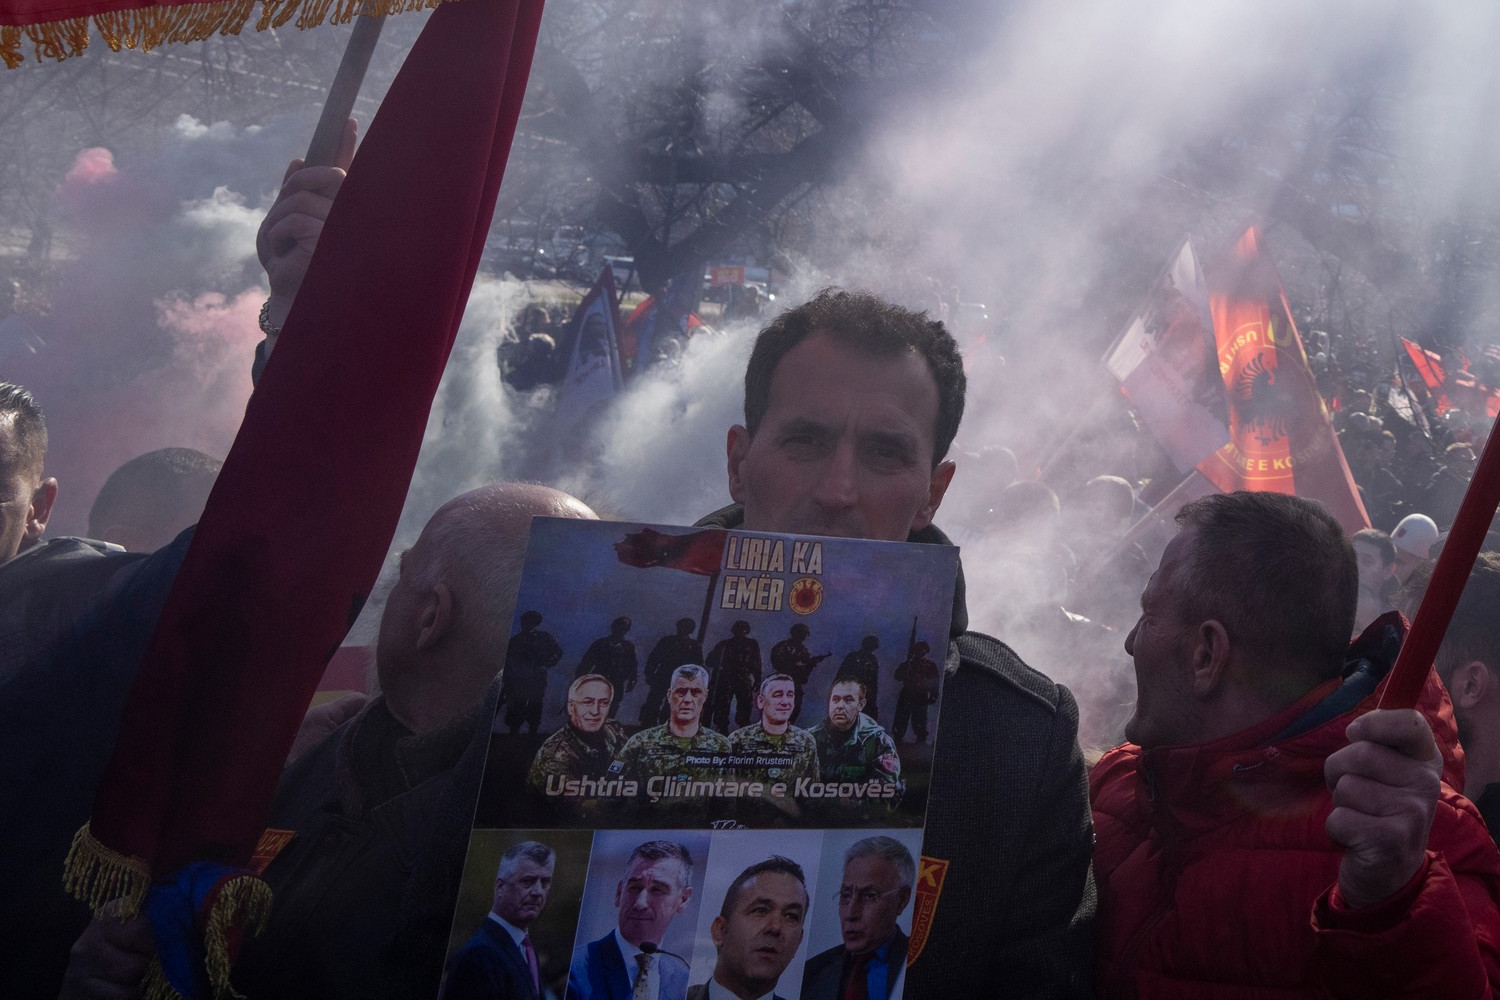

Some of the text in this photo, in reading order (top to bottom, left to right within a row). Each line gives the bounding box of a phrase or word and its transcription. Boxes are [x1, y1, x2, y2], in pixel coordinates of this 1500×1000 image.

[725, 536, 823, 575] LIRIA KA
[720, 573, 785, 611] EMËR
[685, 756, 794, 766] Photo By: Florim Rrustemi
[545, 774, 896, 802] Ushtria Çlirimtare e Kosovës
